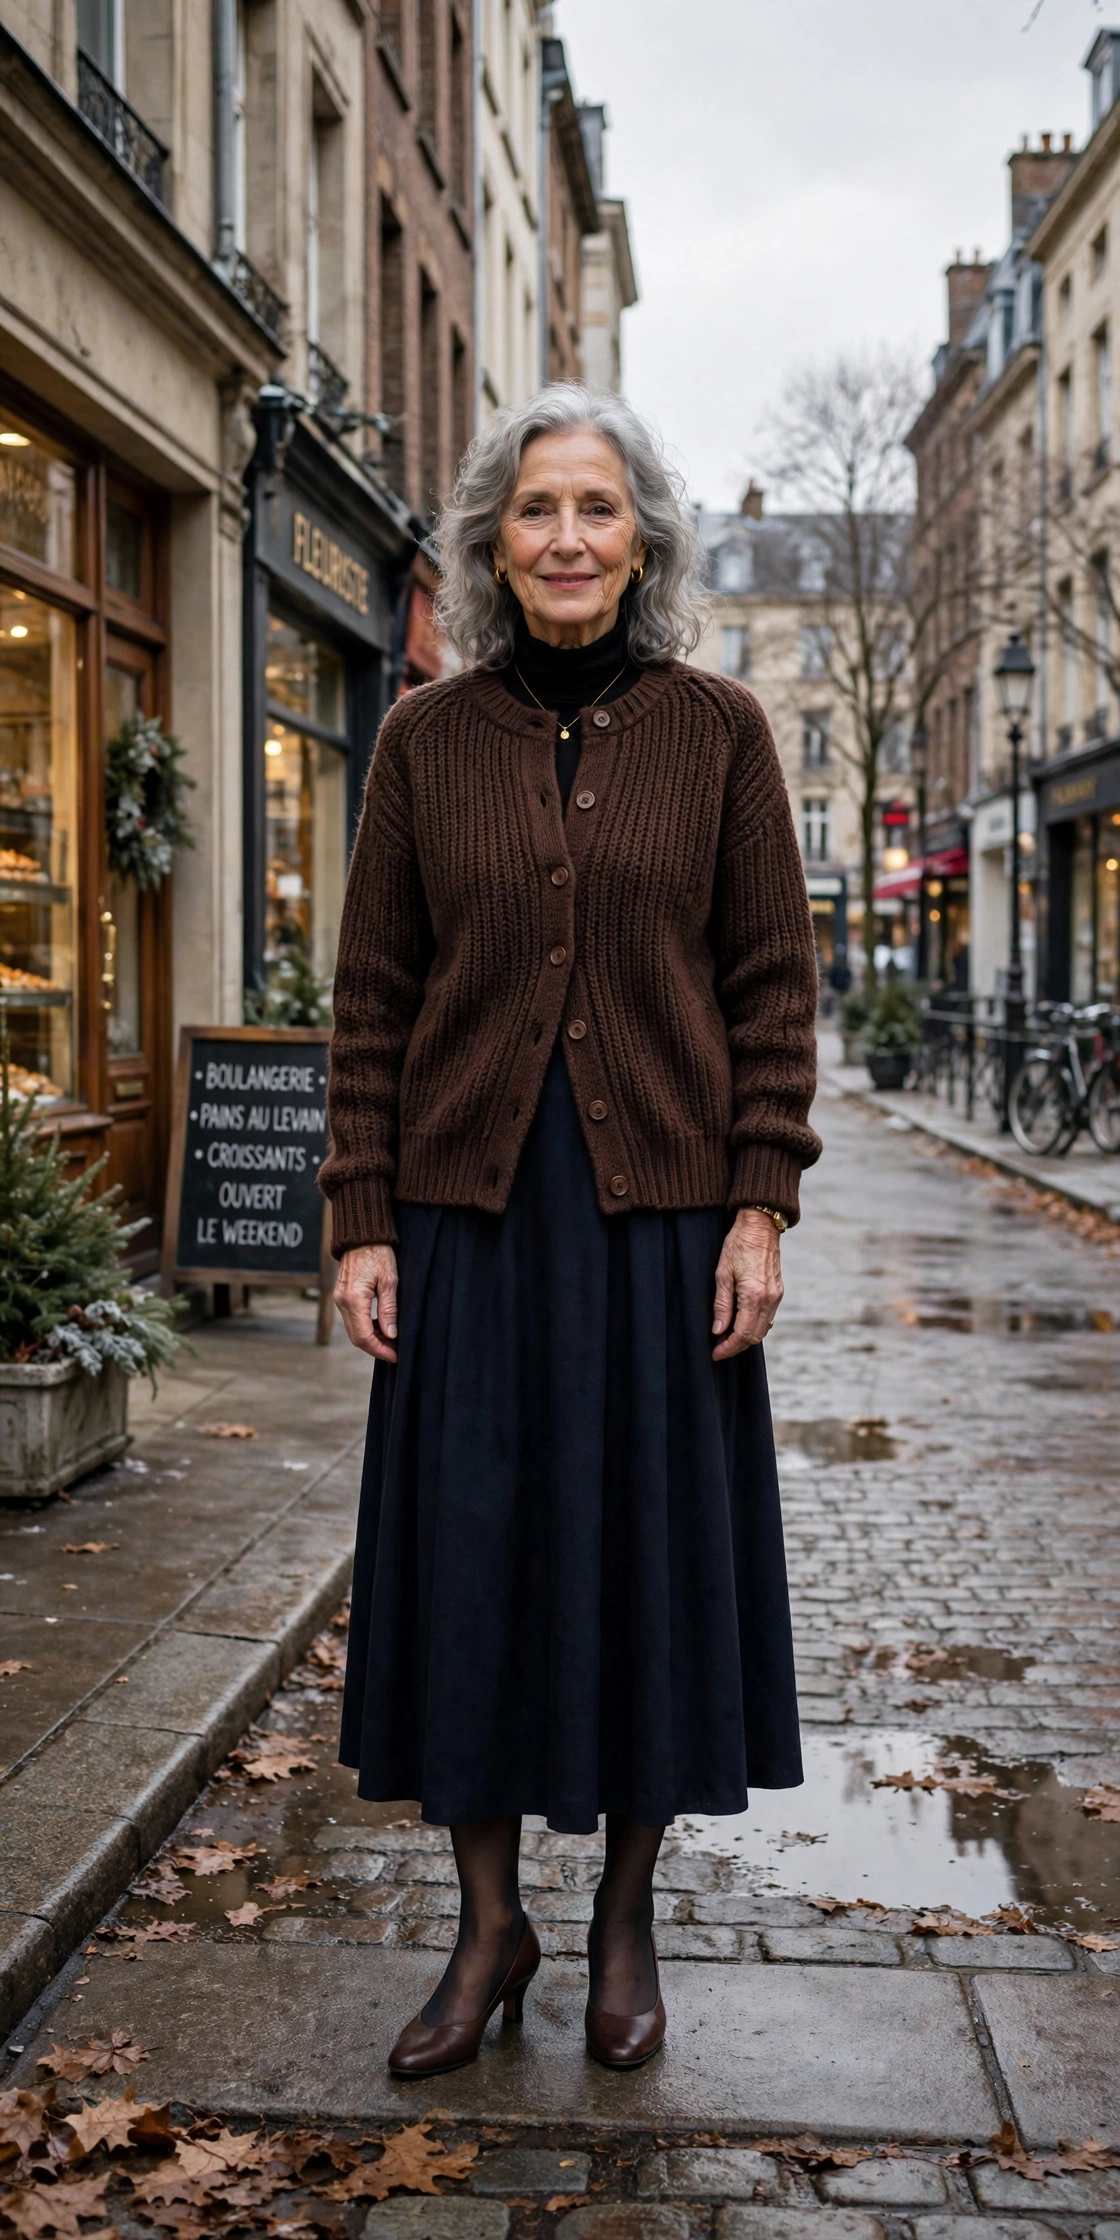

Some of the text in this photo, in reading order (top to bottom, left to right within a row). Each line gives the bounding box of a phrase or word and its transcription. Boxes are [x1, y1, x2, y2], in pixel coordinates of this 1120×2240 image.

[293, 511, 368, 615] FLEURISTE
[206, 1062, 315, 1092] BOULANGERIE
[200, 1103, 326, 1132] PAINS AU LEVAIN
[207, 1141, 306, 1172] CROISSANTS
[218, 1181, 287, 1210] OUVERT
[197, 1217, 303, 1248] LE WEEKEND
